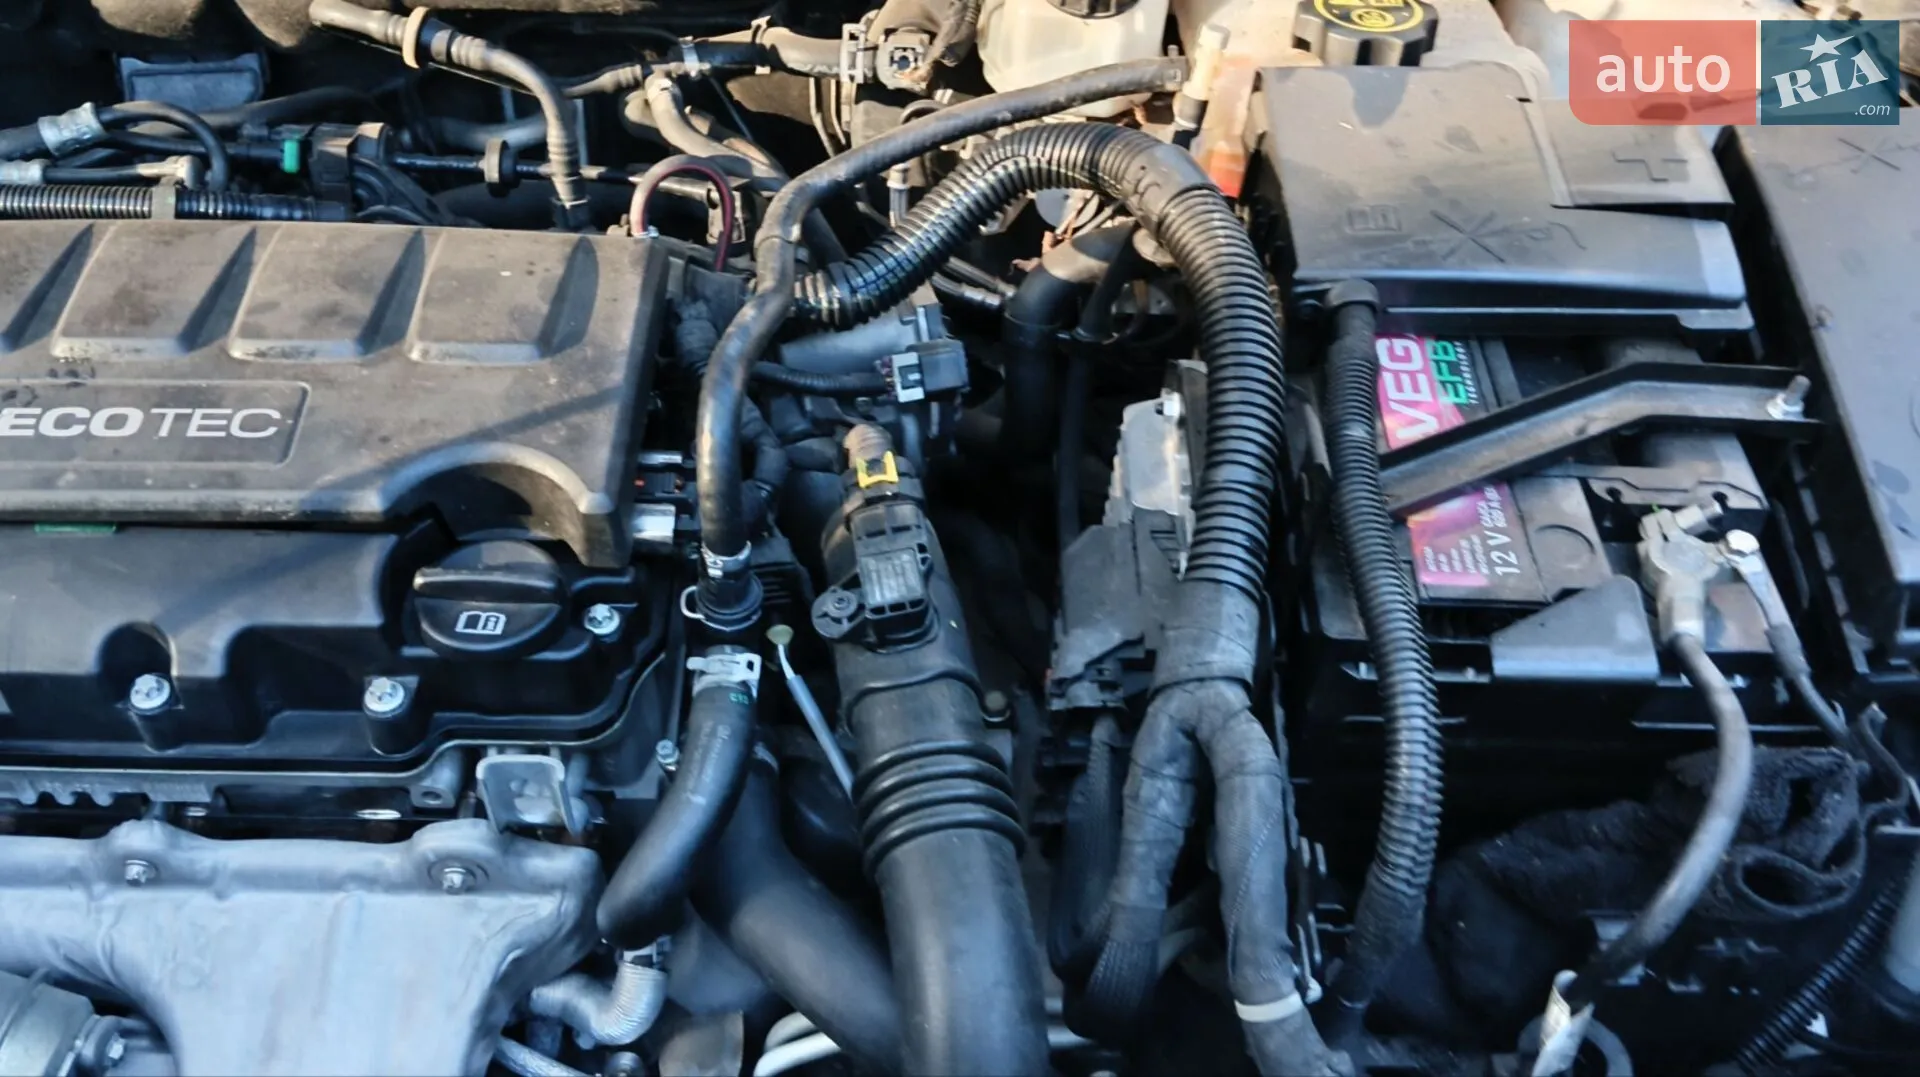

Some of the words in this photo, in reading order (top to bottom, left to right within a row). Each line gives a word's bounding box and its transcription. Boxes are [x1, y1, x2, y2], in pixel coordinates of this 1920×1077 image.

[1376, 334, 1440, 439] VEG
[1426, 338, 1470, 405] EFB
[0, 406, 282, 439] ECOTEC
[1483, 530, 1512, 546] V
[1490, 550, 1520, 576] 12
